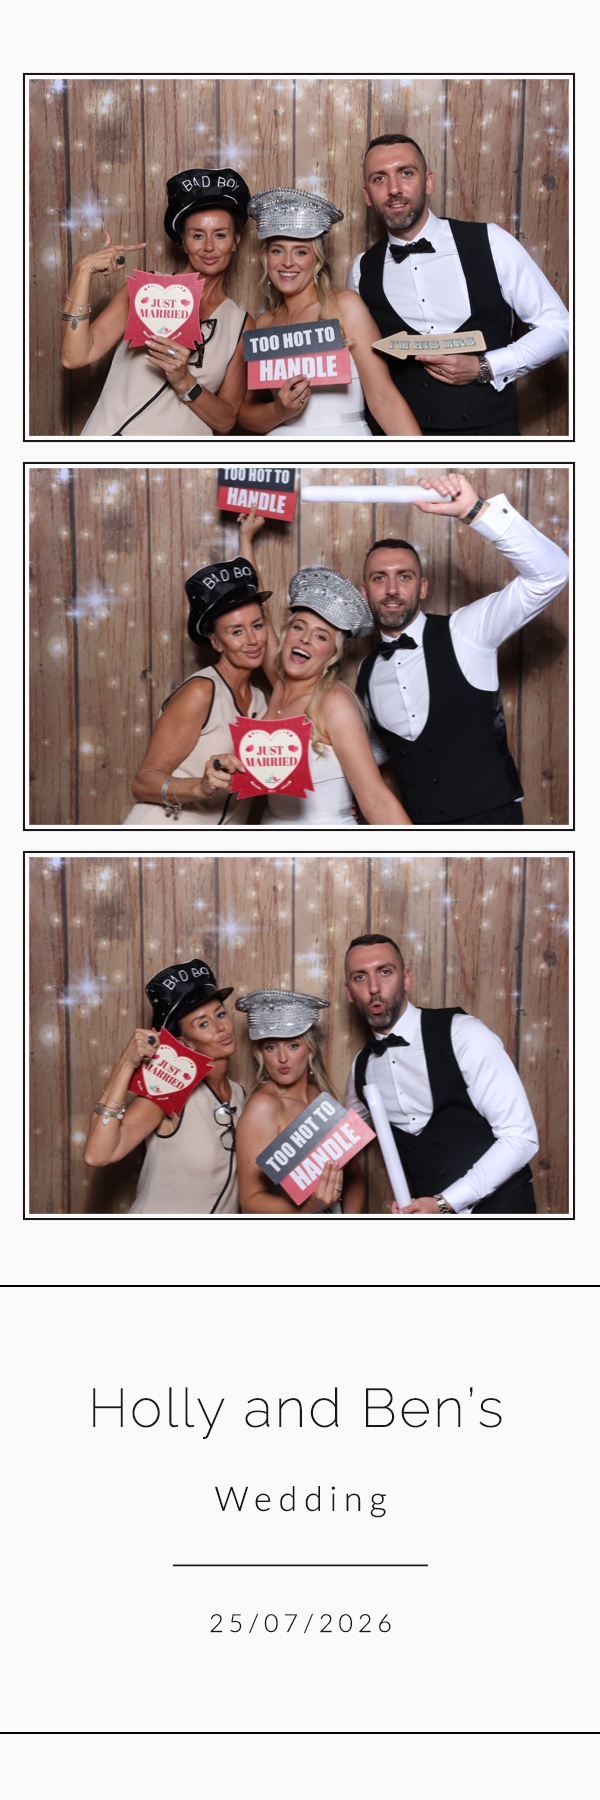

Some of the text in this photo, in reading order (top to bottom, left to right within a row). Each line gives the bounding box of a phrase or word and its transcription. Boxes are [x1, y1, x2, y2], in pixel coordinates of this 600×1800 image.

[182, 175, 211, 192] BAD
[151, 298, 177, 308] JUST
[140, 308, 189, 319] MARRIED
[249, 326, 336, 354] TOO HOT TO
[389, 337, 477, 350] I'M HIS MRS
[259, 355, 338, 382] HANDLE
[223, 467, 290, 484] TOO HOT TO
[226, 486, 287, 515] HANDLE
[202, 566, 252, 590] BAD BO
[256, 746, 284, 756] JUST
[245, 757, 298, 767] MARRIED
[162, 969, 189, 990] BAD
[144, 1063, 185, 1090] MARRIED
[157, 1060, 181, 1076] JUST
[265, 1100, 336, 1173] TOO HOT TO
[289, 1122, 361, 1191] HANDLE
